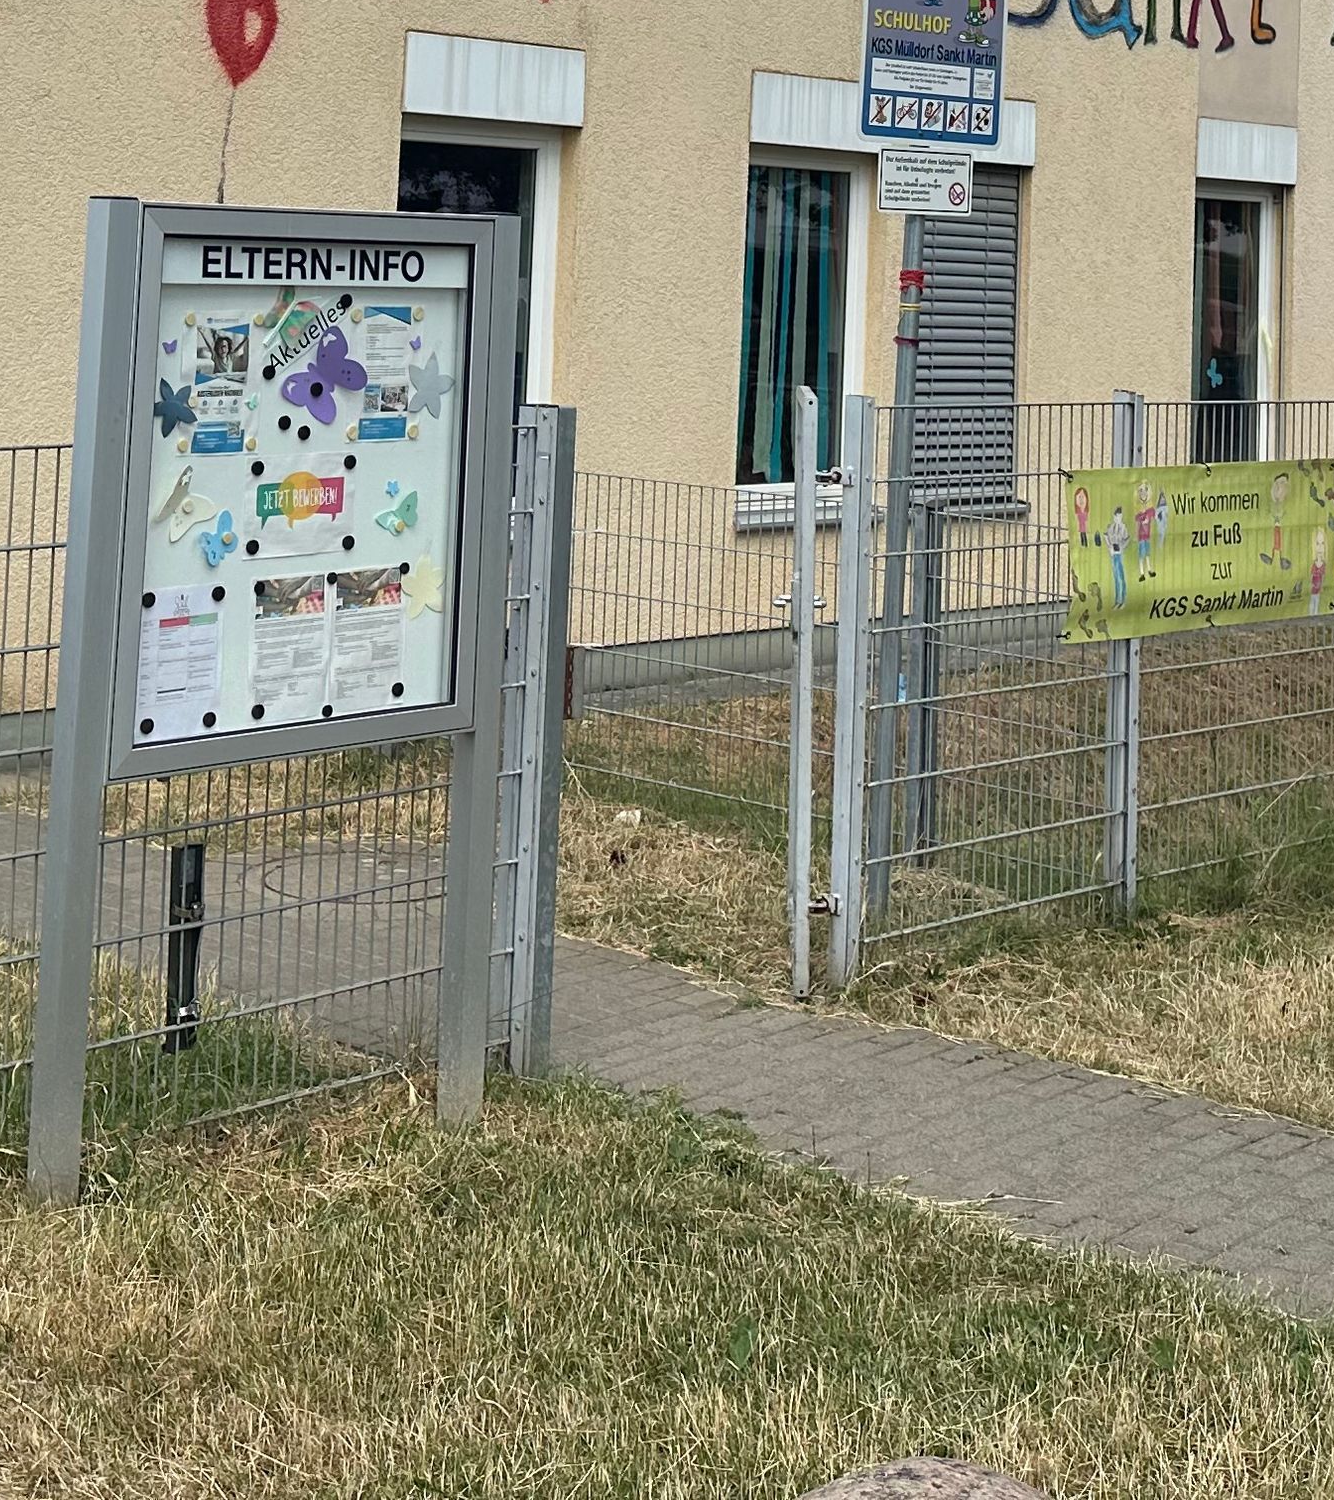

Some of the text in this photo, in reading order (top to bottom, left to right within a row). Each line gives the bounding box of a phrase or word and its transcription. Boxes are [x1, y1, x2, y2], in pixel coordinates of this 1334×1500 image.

[873, 9, 952, 35] SCHULHOF
[871, 36, 997, 67] KGS Mülldorf Sankt Martin
[202, 245, 425, 283] ELTERN-INFO
[263, 486, 338, 510] JETZT BEWERBEN!
[1171, 491, 1260, 515] Wir kommen
[1191, 522, 1242, 548] zu Fuß
[1210, 560, 1233, 581] zur
[1149, 585, 1284, 619] KGS Sankt Martin
